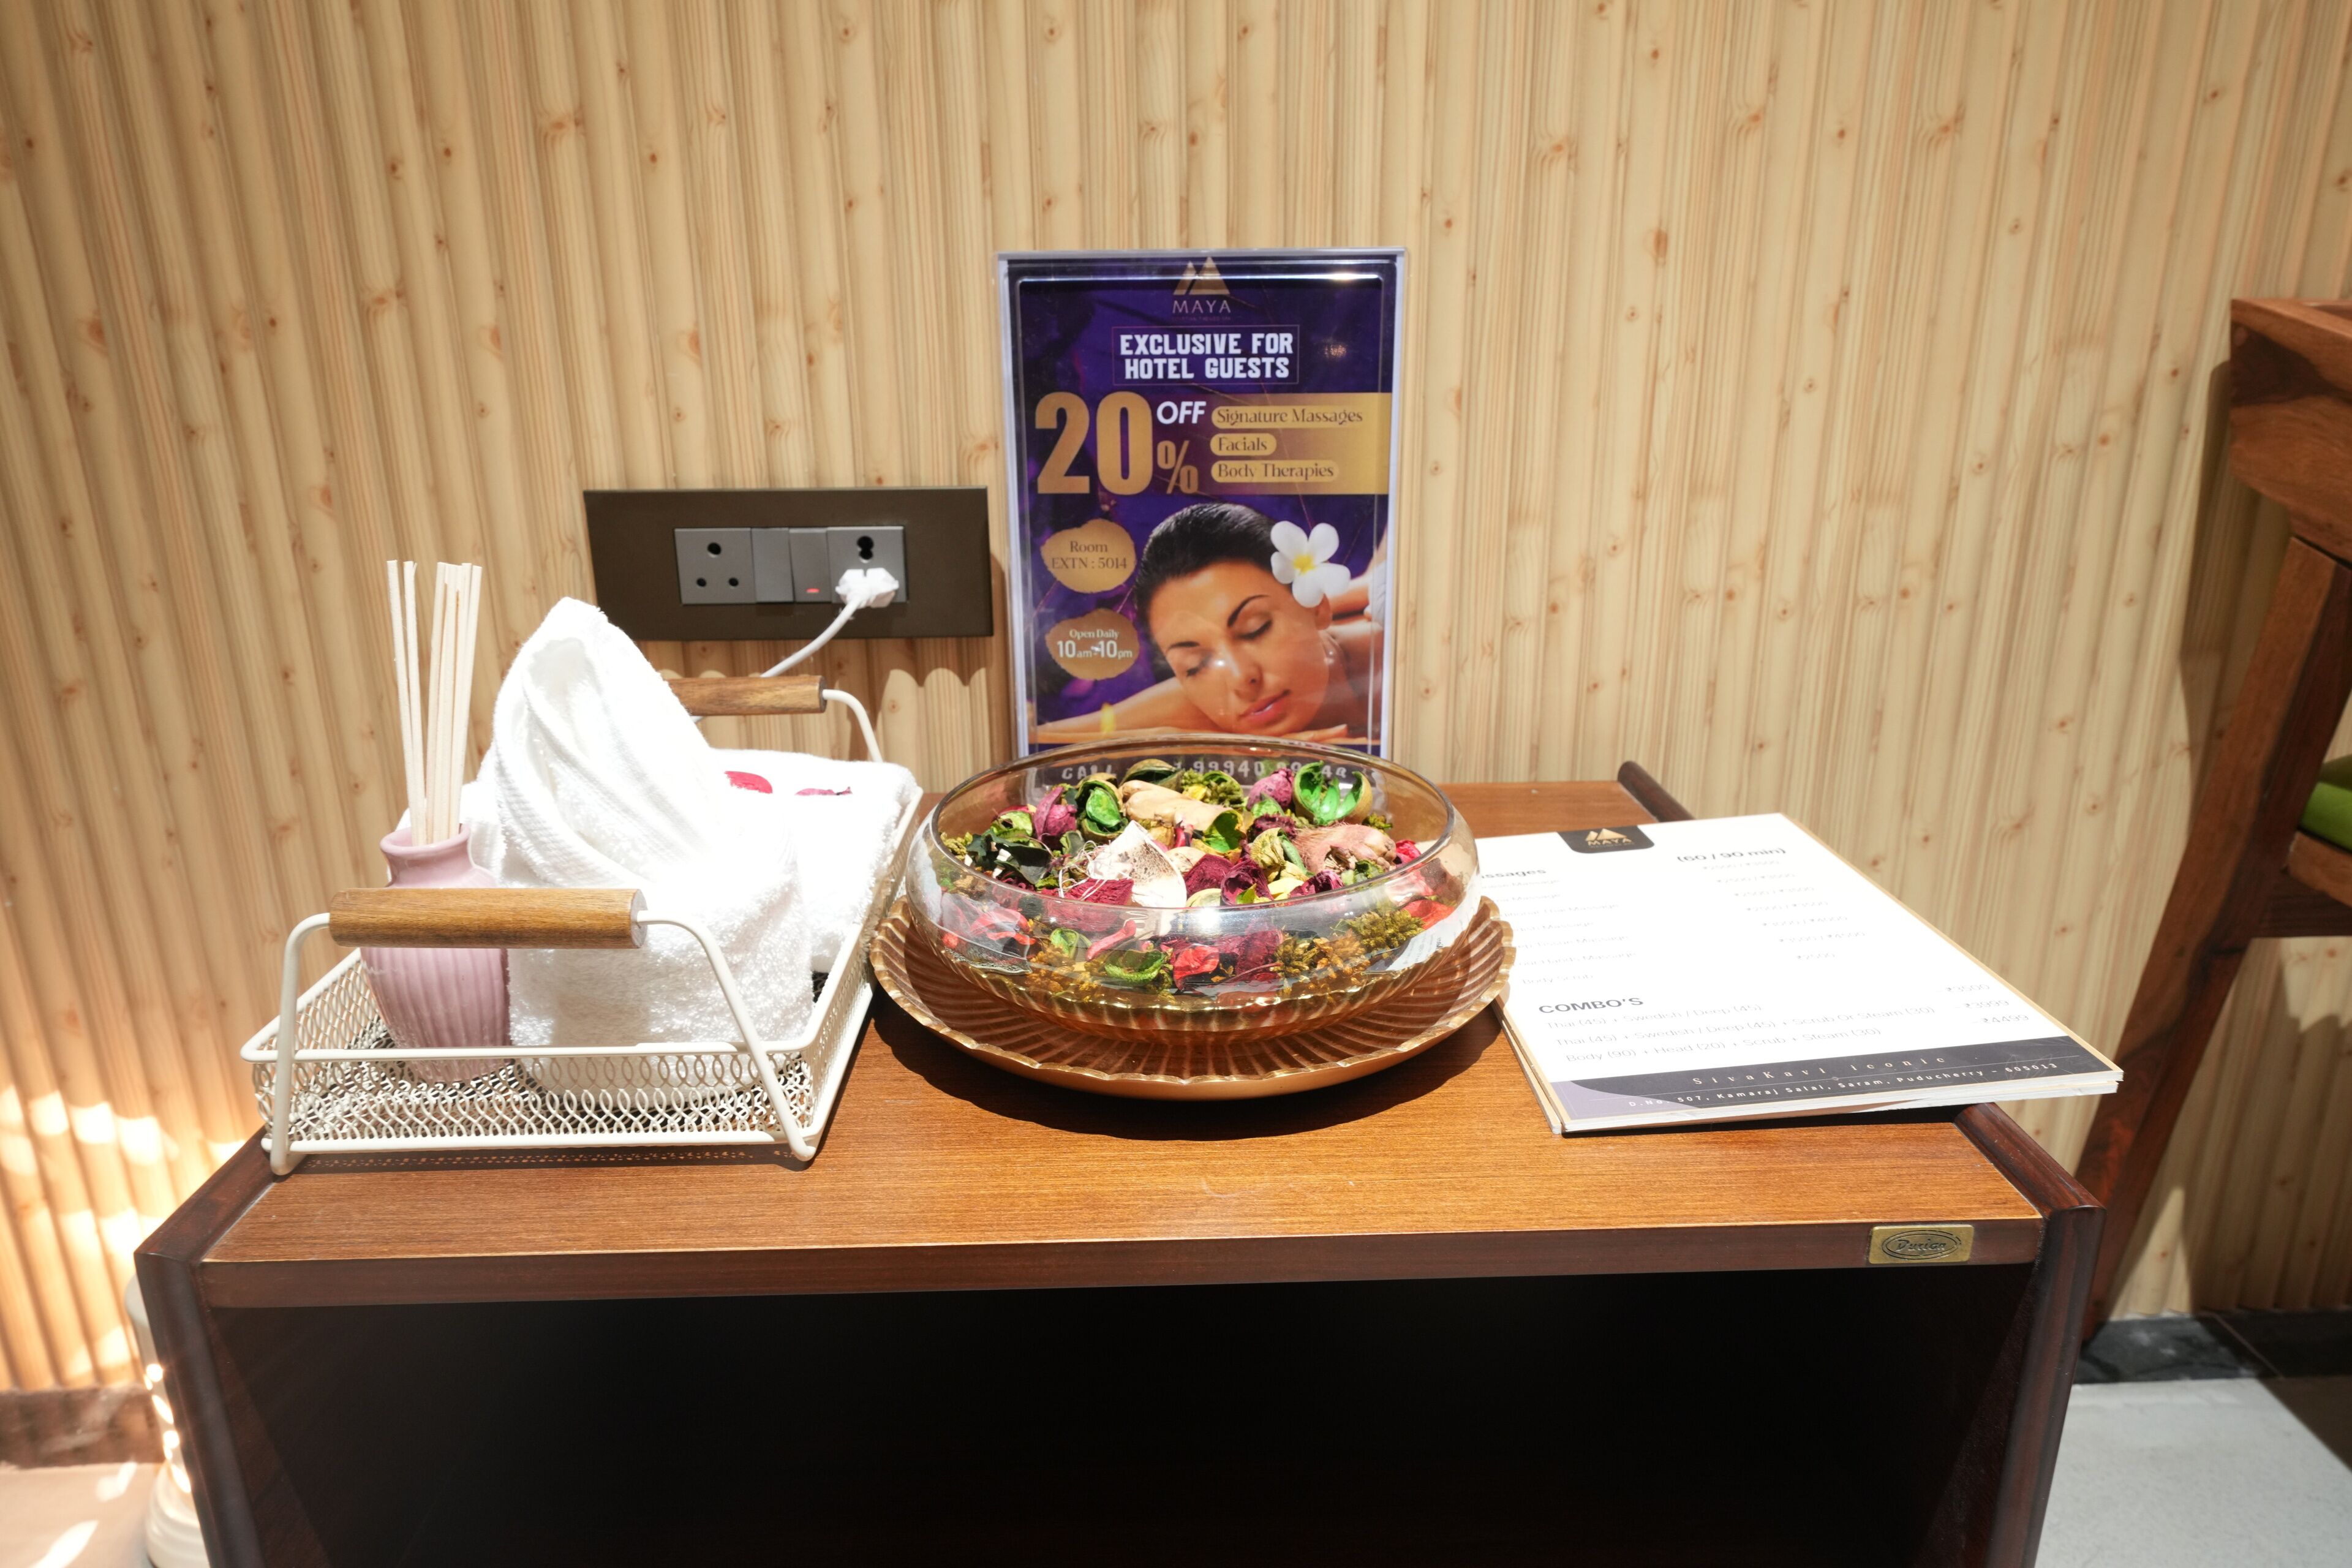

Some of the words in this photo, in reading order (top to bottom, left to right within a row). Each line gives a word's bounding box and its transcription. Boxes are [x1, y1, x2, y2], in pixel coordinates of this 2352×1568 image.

[1172, 300, 1231, 314] MAYA
[1120, 333, 1241, 355] EXCLUSIVE
[1251, 333, 1293, 355] FOR
[1125, 358, 1194, 379] HOTEL
[1205, 357, 1289, 379] GUESTS
[1156, 401, 1207, 424] OFF
[1217, 409, 1288, 426] Signature
[1292, 408, 1363, 424] Massages
[1218, 437, 1267, 451] Facials
[1218, 464, 1256, 477] Body
[1262, 462, 1334, 480] Therapies
[1070, 541, 1108, 552] Room
[1052, 557, 1088, 569] EXTN
[1098, 558, 1127, 569] 5014
[1069, 629, 1095, 639] Open
[1096, 628, 1120, 639] Daily
[1538, 997, 1644, 1014] COMBO'S
[1547, 1021, 1575, 1030] Thai
[1579, 1017, 1607, 1027] (45)
[1624, 1011, 1682, 1022] Swedish
[1694, 1006, 1731, 1017] Deep
[1734, 1003, 1762, 1012] (45)
[1556, 1038, 1585, 1046] Thai
[1589, 1034, 1617, 1044] (45)
[1634, 1027, 1695, 1039] Swedish
[1706, 1023, 1744, 1033] Deep
[1747, 1020, 1776, 1030] (45)
[1792, 1014, 1835, 1026] Scrub
[1838, 1012, 1853, 1021] Or
[1857, 1008, 1903, 1019] Steam
[1566, 1052, 1602, 1063] Body
[1607, 1048, 1637, 1059] (90)
[1653, 1044, 1693, 1054] Head
[1697, 1041, 1725, 1051] (20)
[1743, 1035, 1787, 1047] Scrub
[1802, 1030, 1849, 1042] Steam
[1717, 1088, 1779, 1100] Kamaraj
[1785, 1084, 1831, 1093] Salai,
[1838, 1079, 1891, 1088] Saram,
[1896, 1070, 1985, 1083] Puducherry
[2005, 1063, 2059, 1073] 605013
